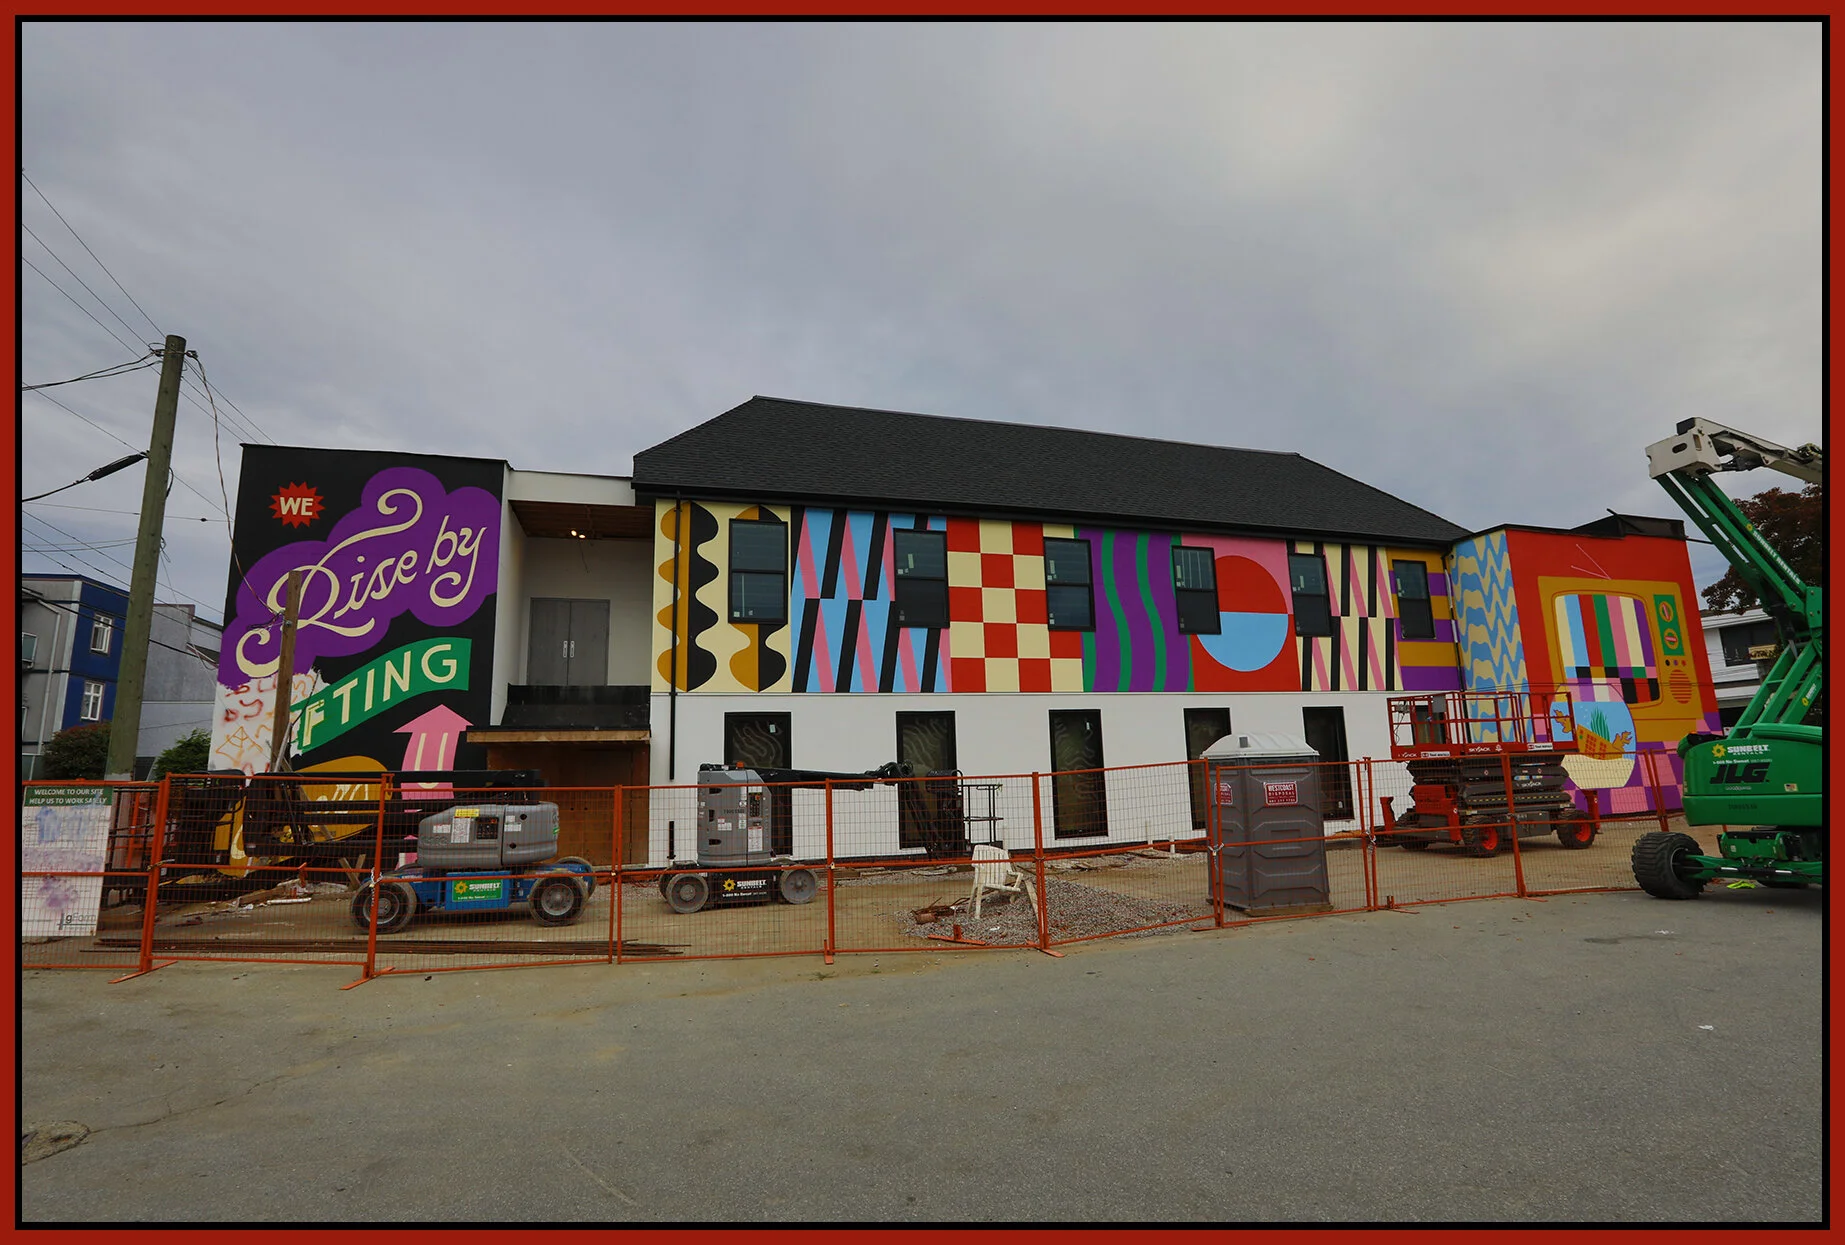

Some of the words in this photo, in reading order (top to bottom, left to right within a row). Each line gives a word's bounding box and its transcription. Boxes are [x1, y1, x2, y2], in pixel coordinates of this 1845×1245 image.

[279, 496, 314, 517] WE
[1752, 530, 1777, 558] SUNBELT
[1776, 556, 1801, 585] RENTALS
[236, 488, 423, 678] Rise
[425, 514, 488, 608] by
[1727, 744, 1769, 754] SUNBELT
[1709, 762, 1771, 785] JLG
[34, 788, 66, 796] WELCOME
[468, 882, 501, 890] SUNBELT
